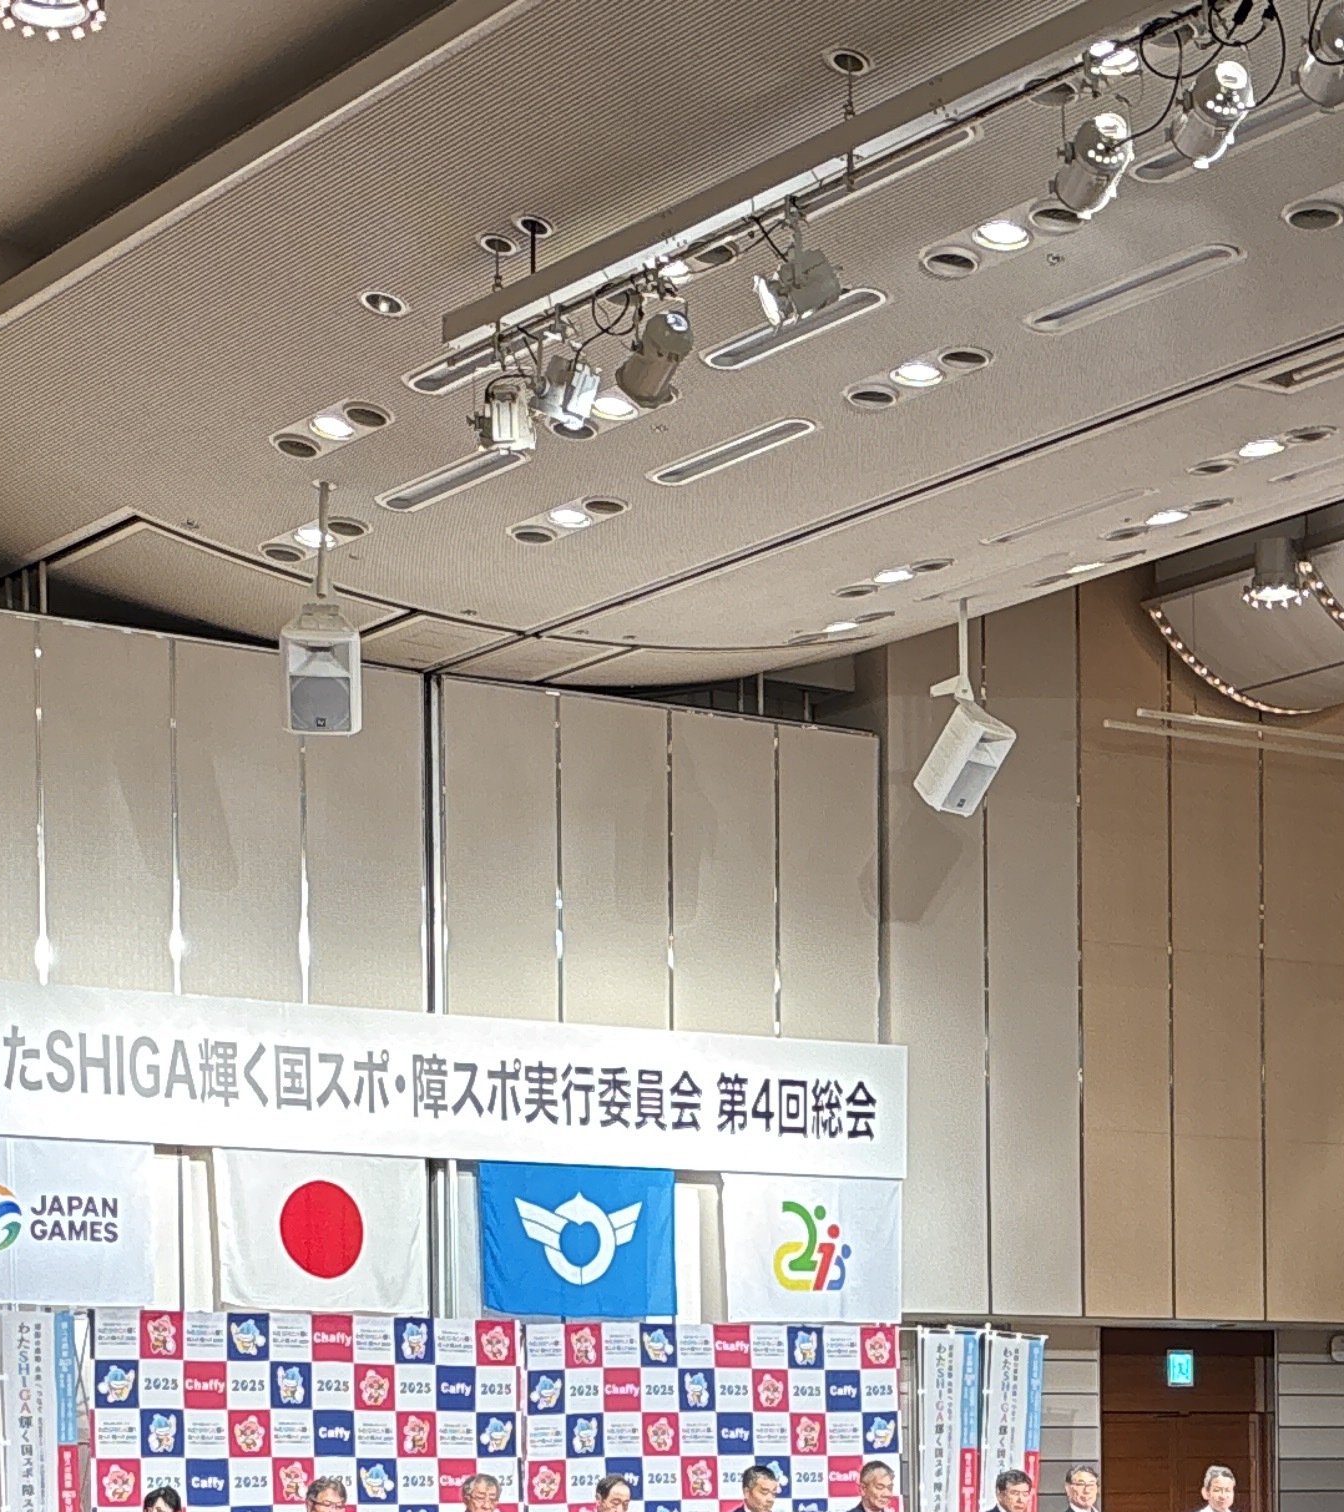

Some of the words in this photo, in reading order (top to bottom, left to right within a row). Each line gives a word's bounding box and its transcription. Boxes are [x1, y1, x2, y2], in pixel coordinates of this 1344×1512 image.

[716, 1073, 877, 1140] 第4回総会
[30, 1194, 119, 1218] JAPAN
[30, 1219, 119, 1243] GAMES
[144, 1378, 179, 1391] 2025
[232, 1378, 265, 1392] 2025
[316, 1379, 350, 1392] 2025
[399, 1381, 432, 1394] 2025
[480, 1383, 513, 1395] 2025
[645, 1385, 674, 1396] 2025
[719, 1385, 749, 1396] 2025
[865, 1384, 893, 1396] 2025
[570, 1385, 599, 1397] 2025
[792, 1385, 821, 1397] 2025
[234, 1475, 268, 1488] 2025
[402, 1475, 434, 1488] 2025
[499, 1475, 513, 1487] 25
[648, 1472, 677, 1484] 2025
[722, 1472, 743, 1483] 202
[796, 1471, 824, 1483] 2025
